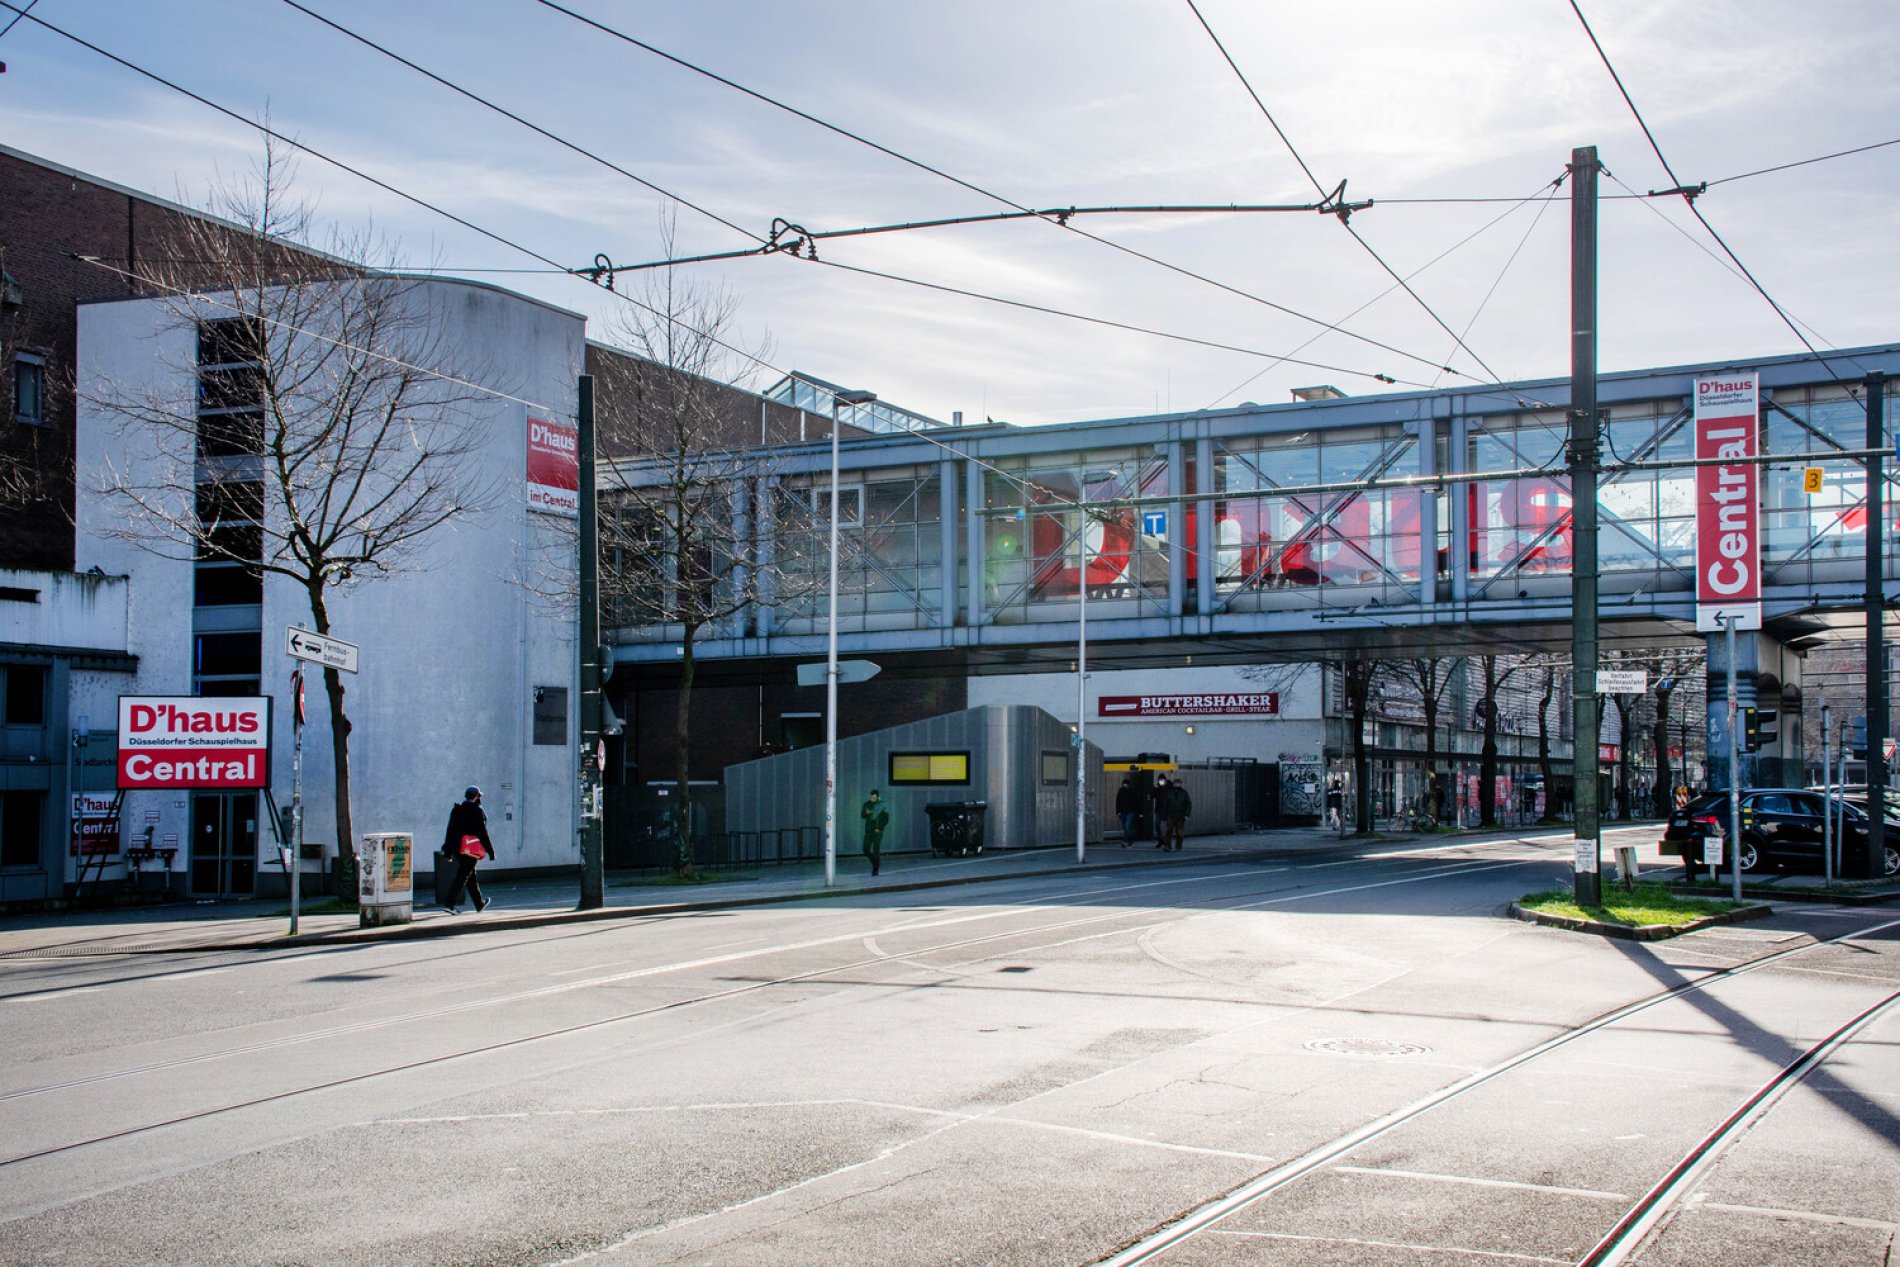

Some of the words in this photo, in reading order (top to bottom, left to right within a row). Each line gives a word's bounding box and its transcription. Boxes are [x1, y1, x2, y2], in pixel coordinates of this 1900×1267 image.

[1700, 381, 1752, 394] D'haus
[530, 424, 575, 451] D'haus
[1809, 473, 1819, 489] 3
[530, 489, 541, 504] im
[543, 492, 576, 509] Central
[1706, 426, 1749, 595] Central
[1140, 695, 1271, 708] BUTTERSHAKER
[129, 704, 259, 733] D'haus
[129, 737, 186, 746] Düsseldorfer
[188, 737, 257, 747] Schauspielhaus
[125, 754, 256, 781] Central
